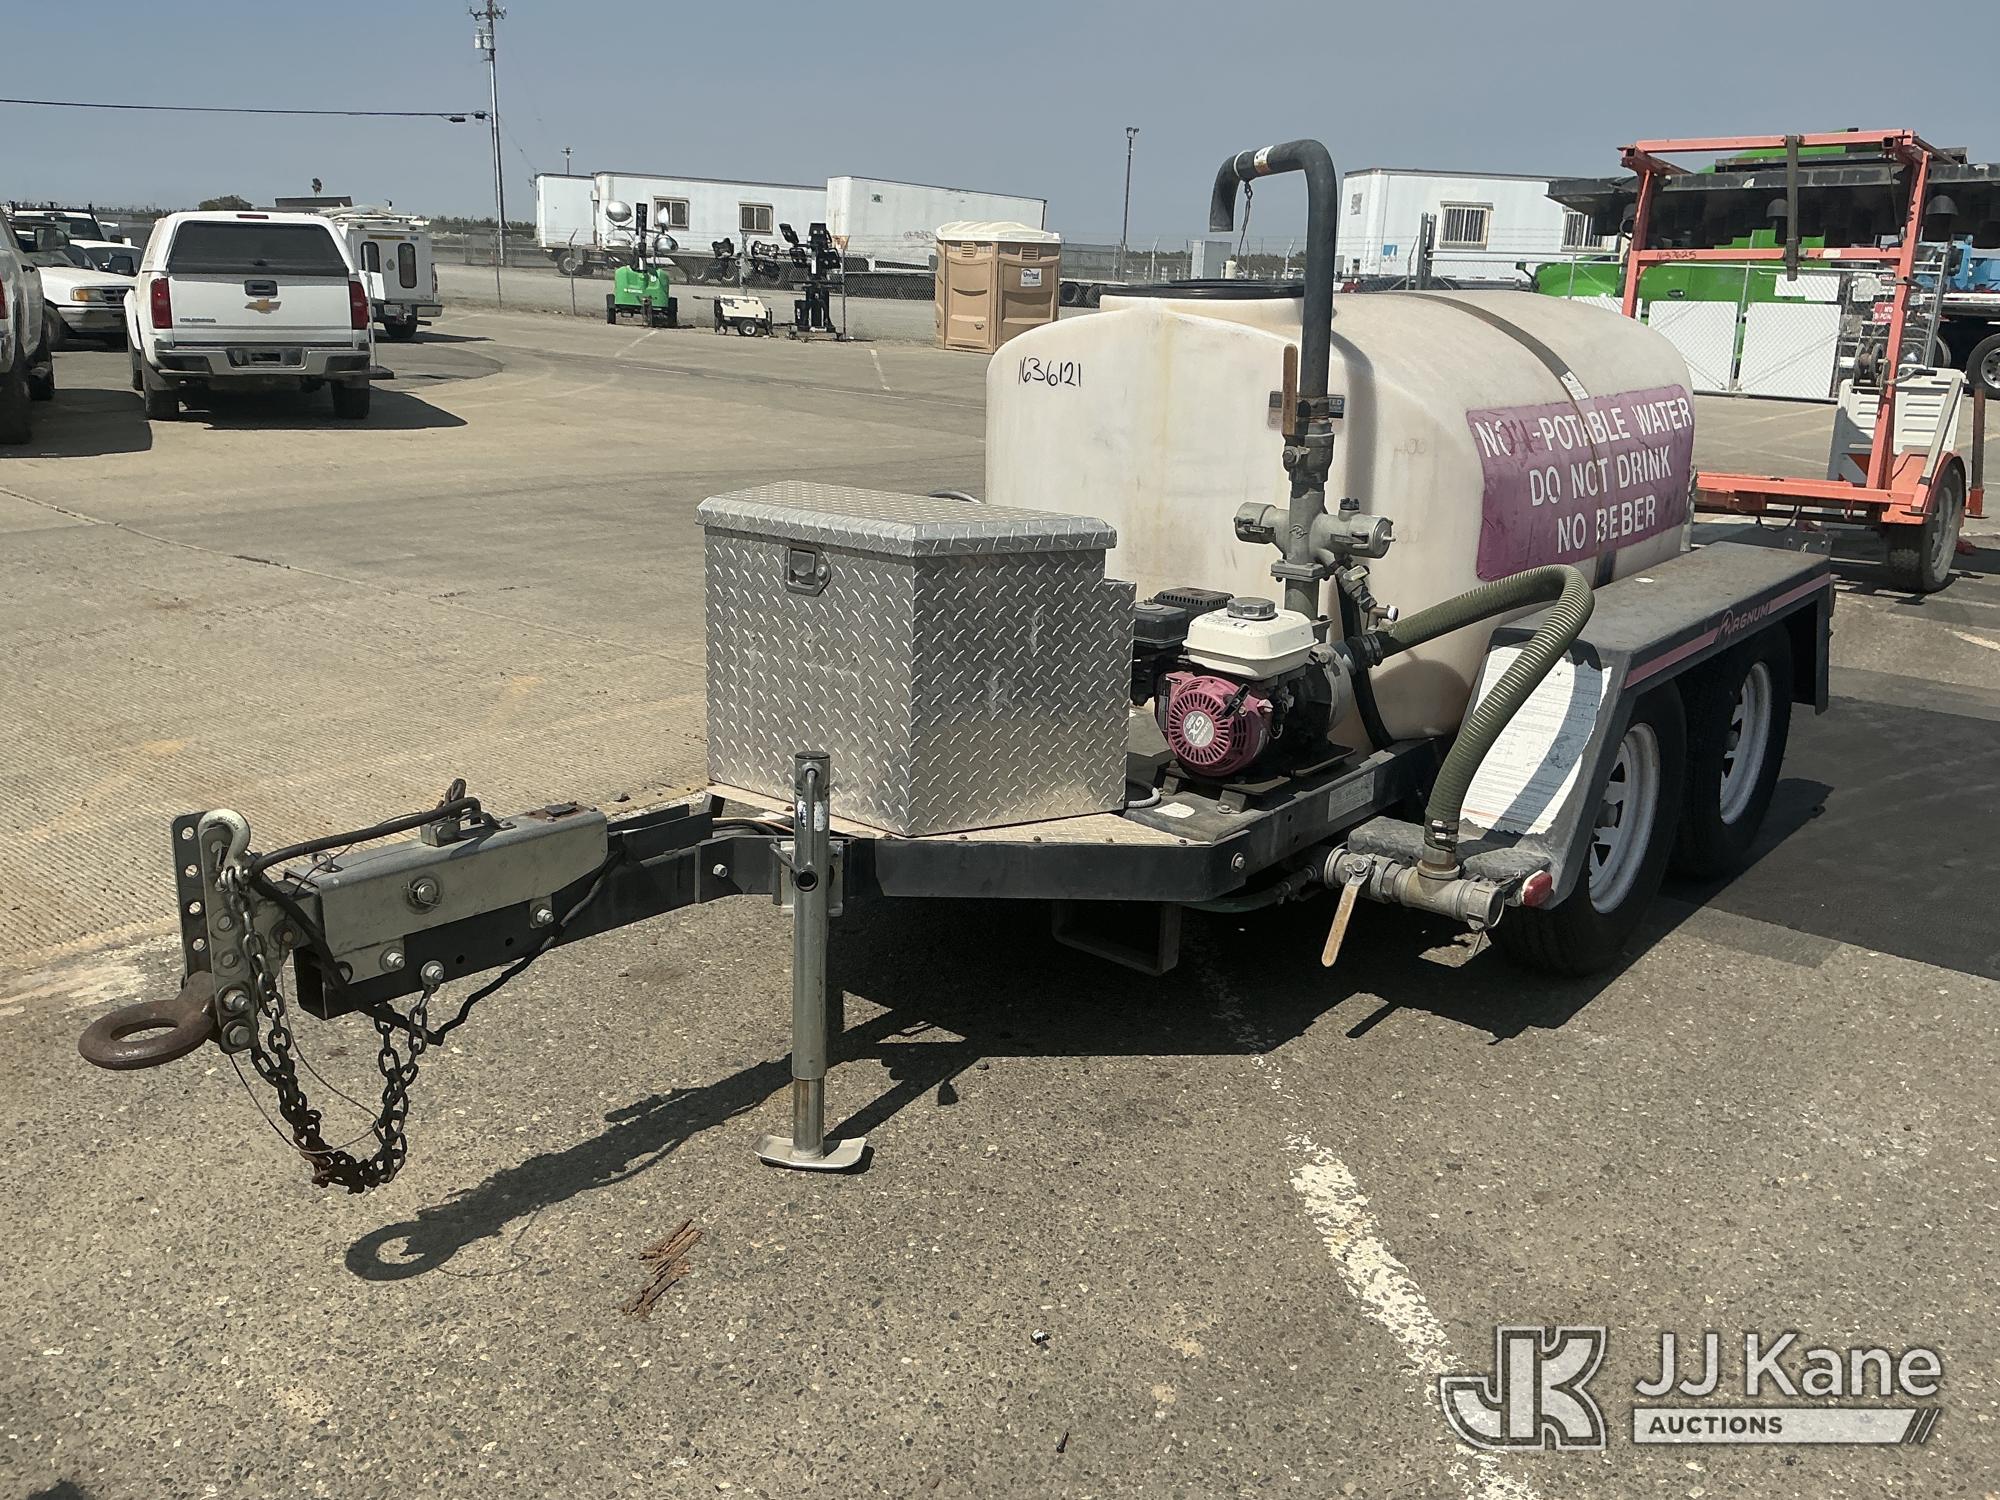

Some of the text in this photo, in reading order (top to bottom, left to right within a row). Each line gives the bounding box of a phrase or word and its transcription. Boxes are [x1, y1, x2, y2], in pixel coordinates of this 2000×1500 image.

[1018, 356, 1081, 387] 1636121
[1631, 397, 1693, 436] WATER
[1529, 445, 1672, 506] DO NOT DRINK
[1557, 495, 1656, 553] NO BEBER
